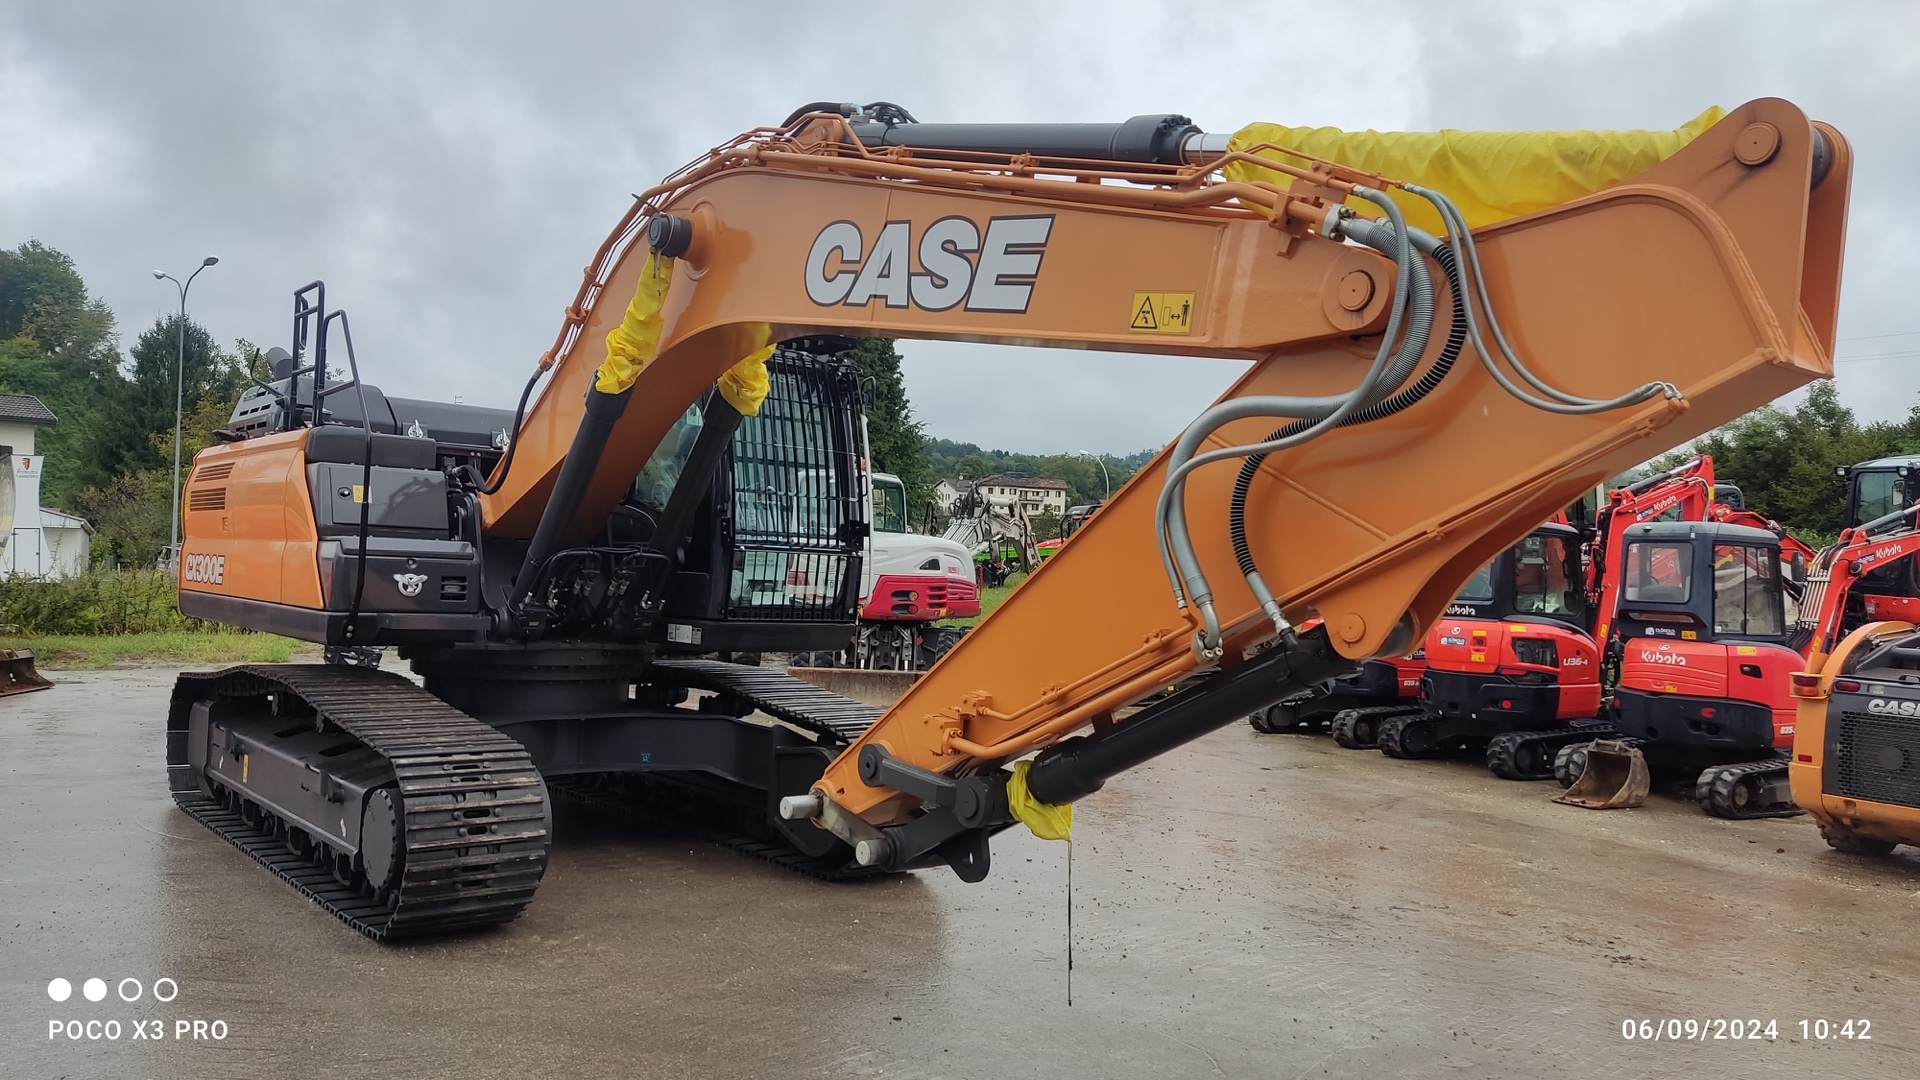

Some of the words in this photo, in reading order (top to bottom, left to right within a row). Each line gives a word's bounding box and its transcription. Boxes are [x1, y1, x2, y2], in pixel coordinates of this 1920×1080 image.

[804, 214, 1056, 313] CASE
[1653, 495, 1677, 511] Kubota
[1876, 543, 1902, 559] Kubota
[185, 553, 225, 585] CX300E
[1563, 657, 1588, 667] U36-4
[1641, 650, 1686, 666] Kubota
